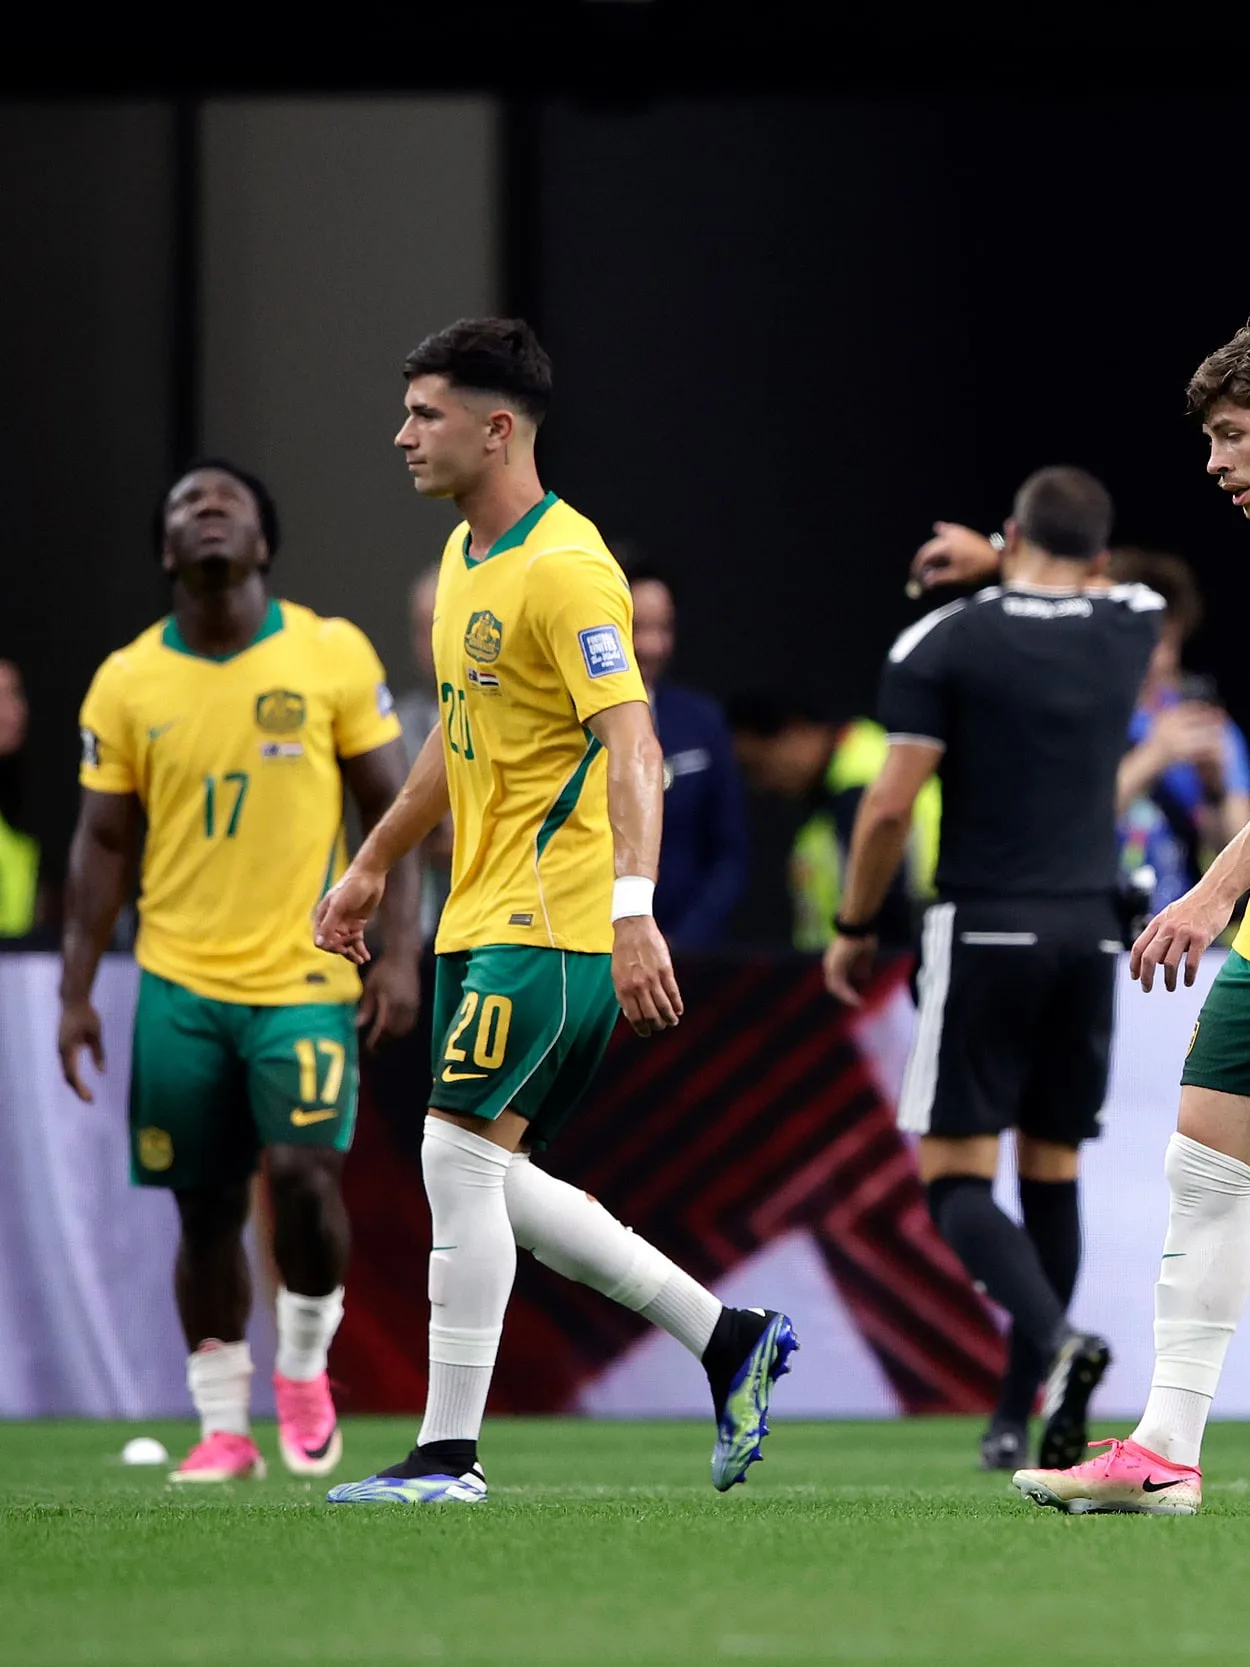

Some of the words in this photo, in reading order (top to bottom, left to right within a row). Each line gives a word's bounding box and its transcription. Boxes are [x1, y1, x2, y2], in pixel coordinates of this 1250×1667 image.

[589, 641, 618, 655] UNITES
[441, 682, 475, 760] 20
[205, 770, 250, 839] 17
[444, 991, 513, 1070] 20
[295, 1038, 346, 1105] 17
